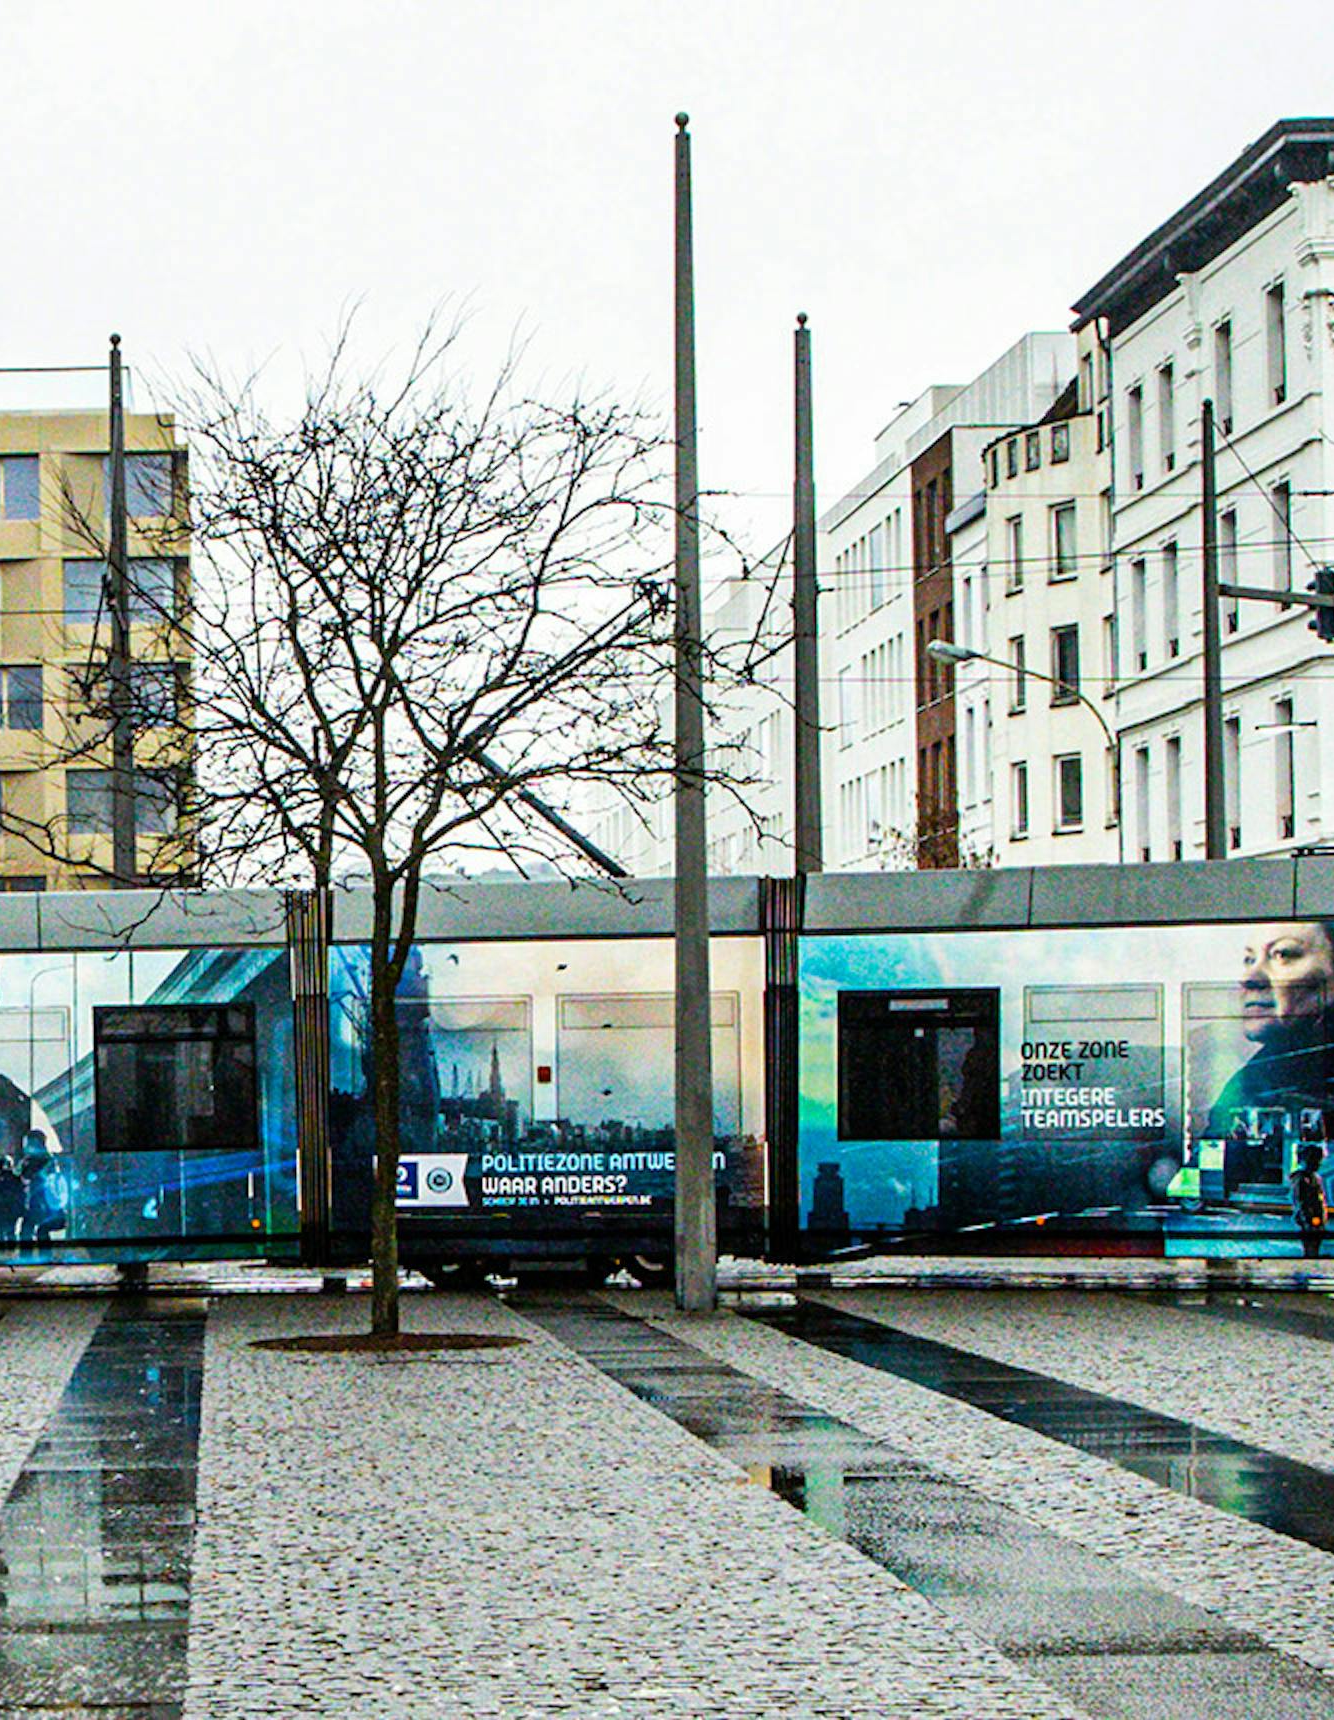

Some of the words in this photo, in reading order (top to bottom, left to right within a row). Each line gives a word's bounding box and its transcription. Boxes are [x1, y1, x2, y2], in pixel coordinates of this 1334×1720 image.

[1021, 1041, 1072, 1060] ONZE
[1078, 1040, 1129, 1058] ZONE
[1021, 1063, 1084, 1081] ZOEKT
[1021, 1086, 1116, 1107] INTEGERE
[1021, 1107, 1165, 1129] TEAMSPELERS
[481, 1152, 605, 1173] POLITIEZONE
[609, 1151, 727, 1171] ANTWEN
[481, 1176, 538, 1195] WAAR
[541, 1174, 628, 1194] ANDERS?
